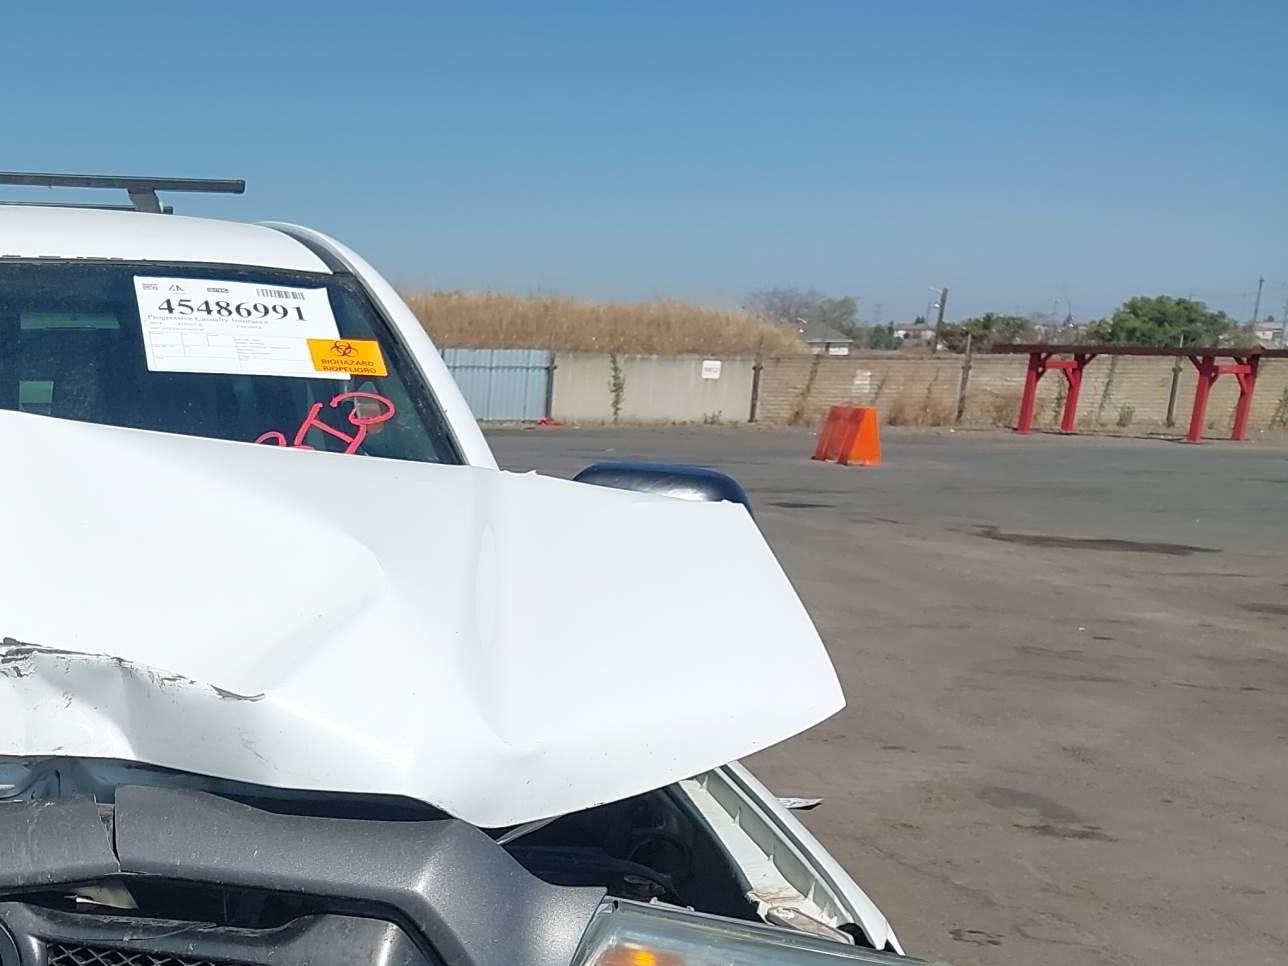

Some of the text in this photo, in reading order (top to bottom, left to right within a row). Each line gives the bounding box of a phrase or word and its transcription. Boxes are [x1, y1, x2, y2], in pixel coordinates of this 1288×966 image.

[158, 297, 309, 322] 45486991
[147, 314, 193, 322] Progressive
[320, 358, 374, 367] BIOHAZARD
[322, 365, 377, 374] BIOPELIGRO
